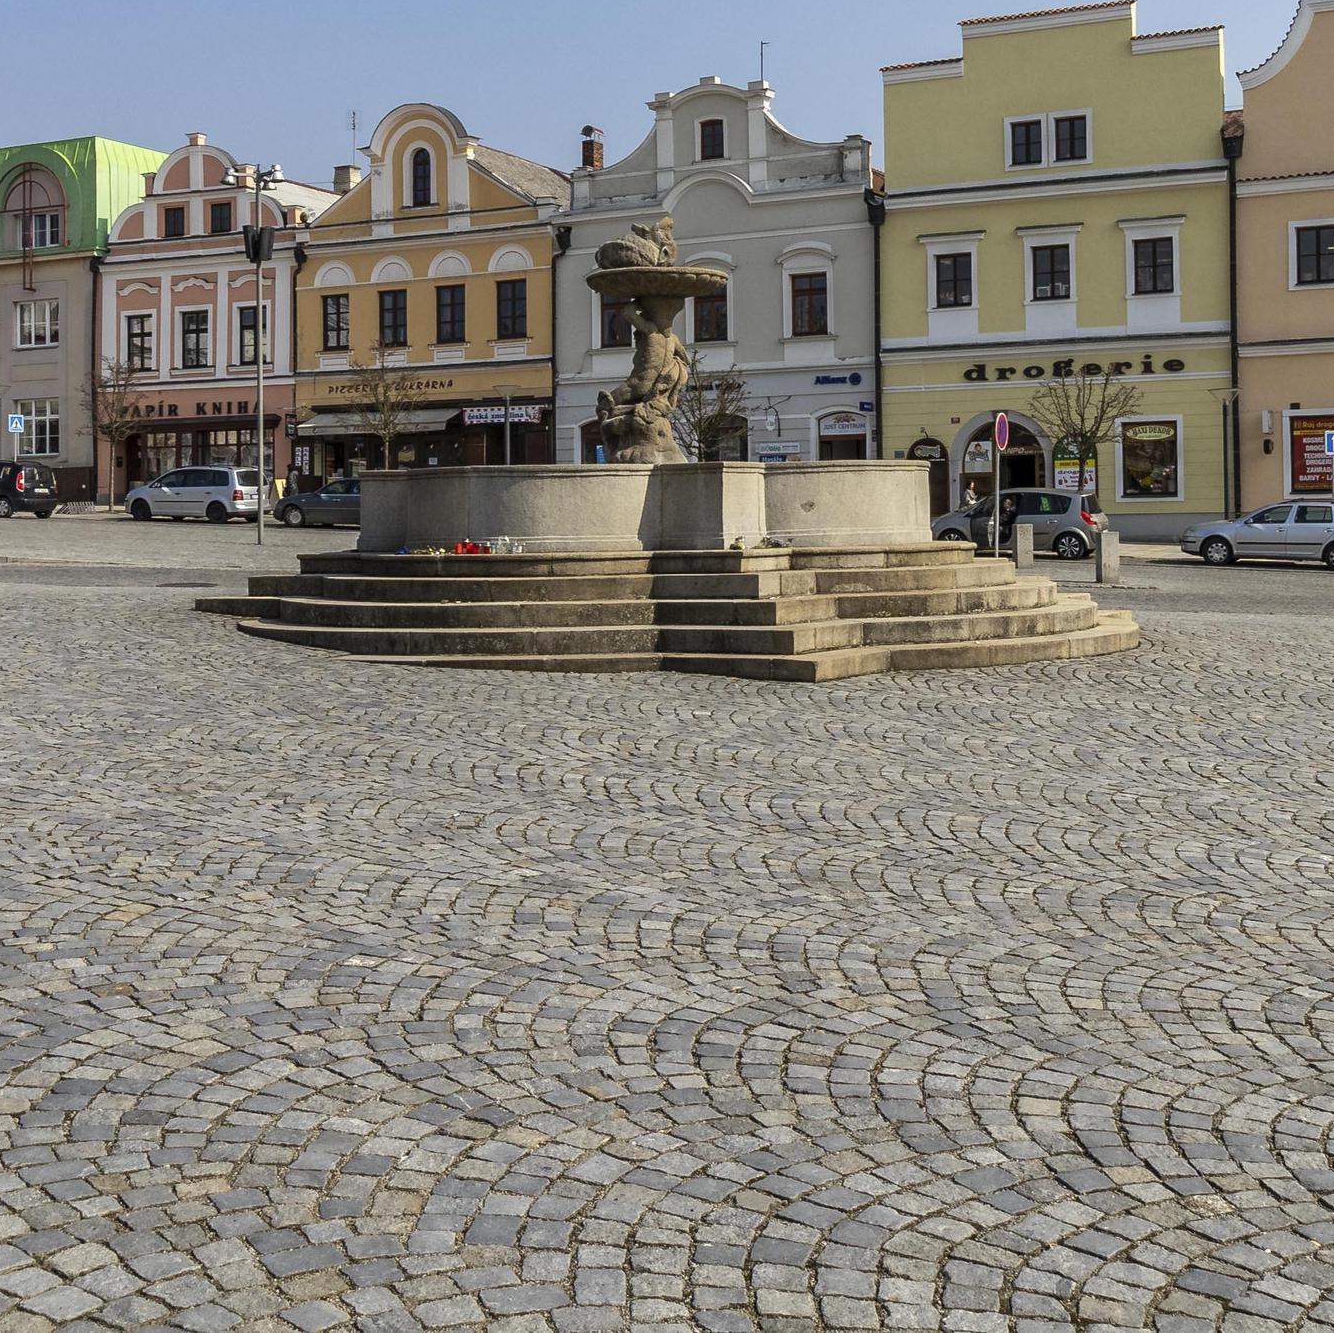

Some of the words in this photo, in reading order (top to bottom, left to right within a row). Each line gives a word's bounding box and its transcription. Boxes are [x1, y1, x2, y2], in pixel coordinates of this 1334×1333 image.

[964, 354, 1185, 381] drogerie
[814, 375, 848, 385] Allianz
[119, 400, 179, 417] PAPÍR
[490, 412, 525, 420] zmrlina
